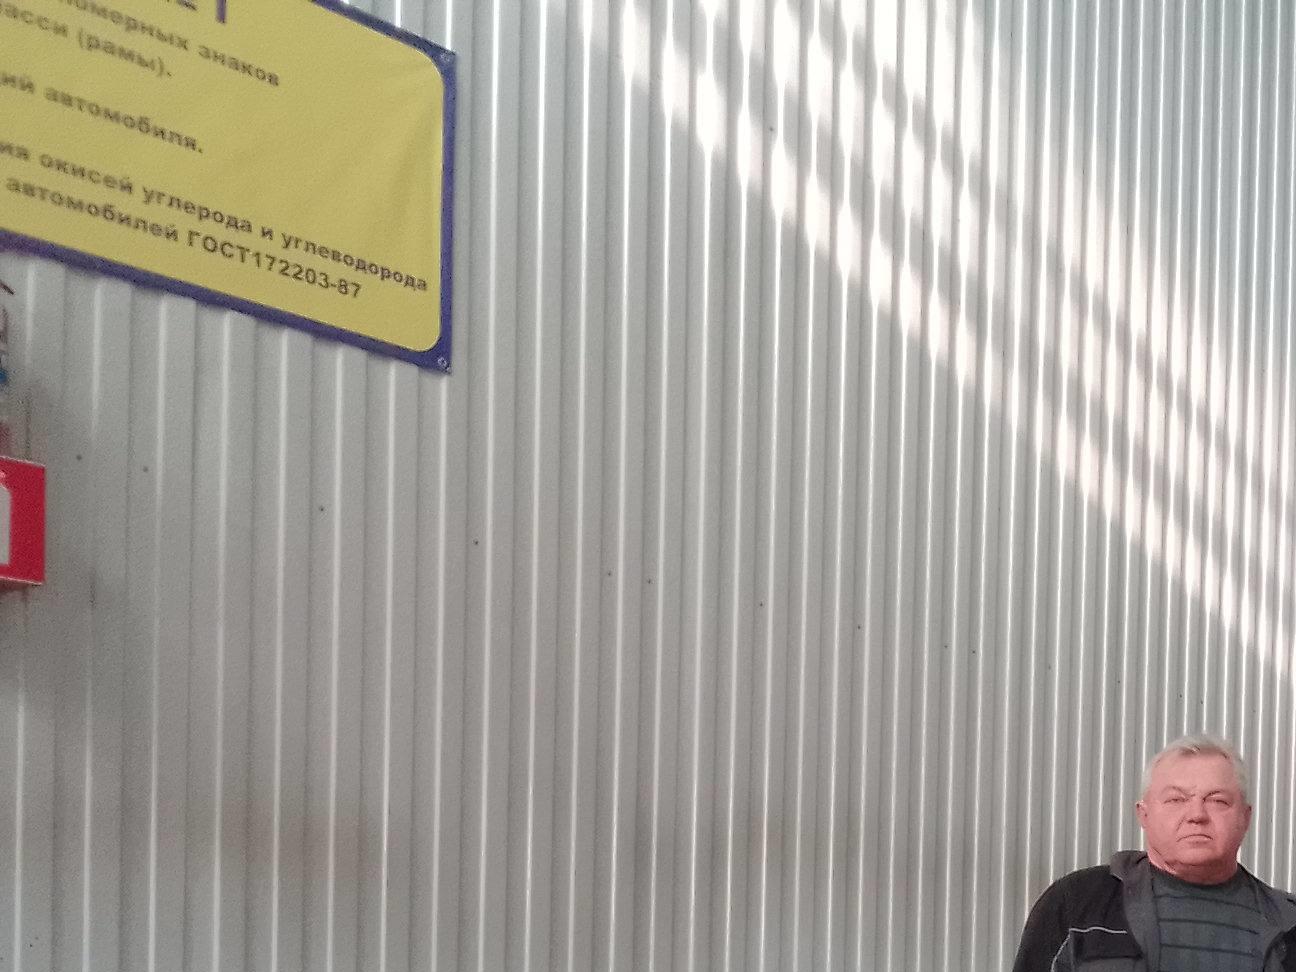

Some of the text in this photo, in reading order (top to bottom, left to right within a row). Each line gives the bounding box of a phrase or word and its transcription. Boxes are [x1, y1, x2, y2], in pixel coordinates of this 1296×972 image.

[0, 3, 68, 37] асси
[60, 0, 189, 50] омерных
[198, 44, 279, 87] знаков
[44, 86, 203, 154] автомобиля.
[6, 176, 362, 299] автомобилей ГОСТ172203-87
[39, 153, 133, 195] окисей
[142, 186, 253, 234] углерода
[261, 226, 274, 241] и
[281, 231, 428, 292] углеводорода
